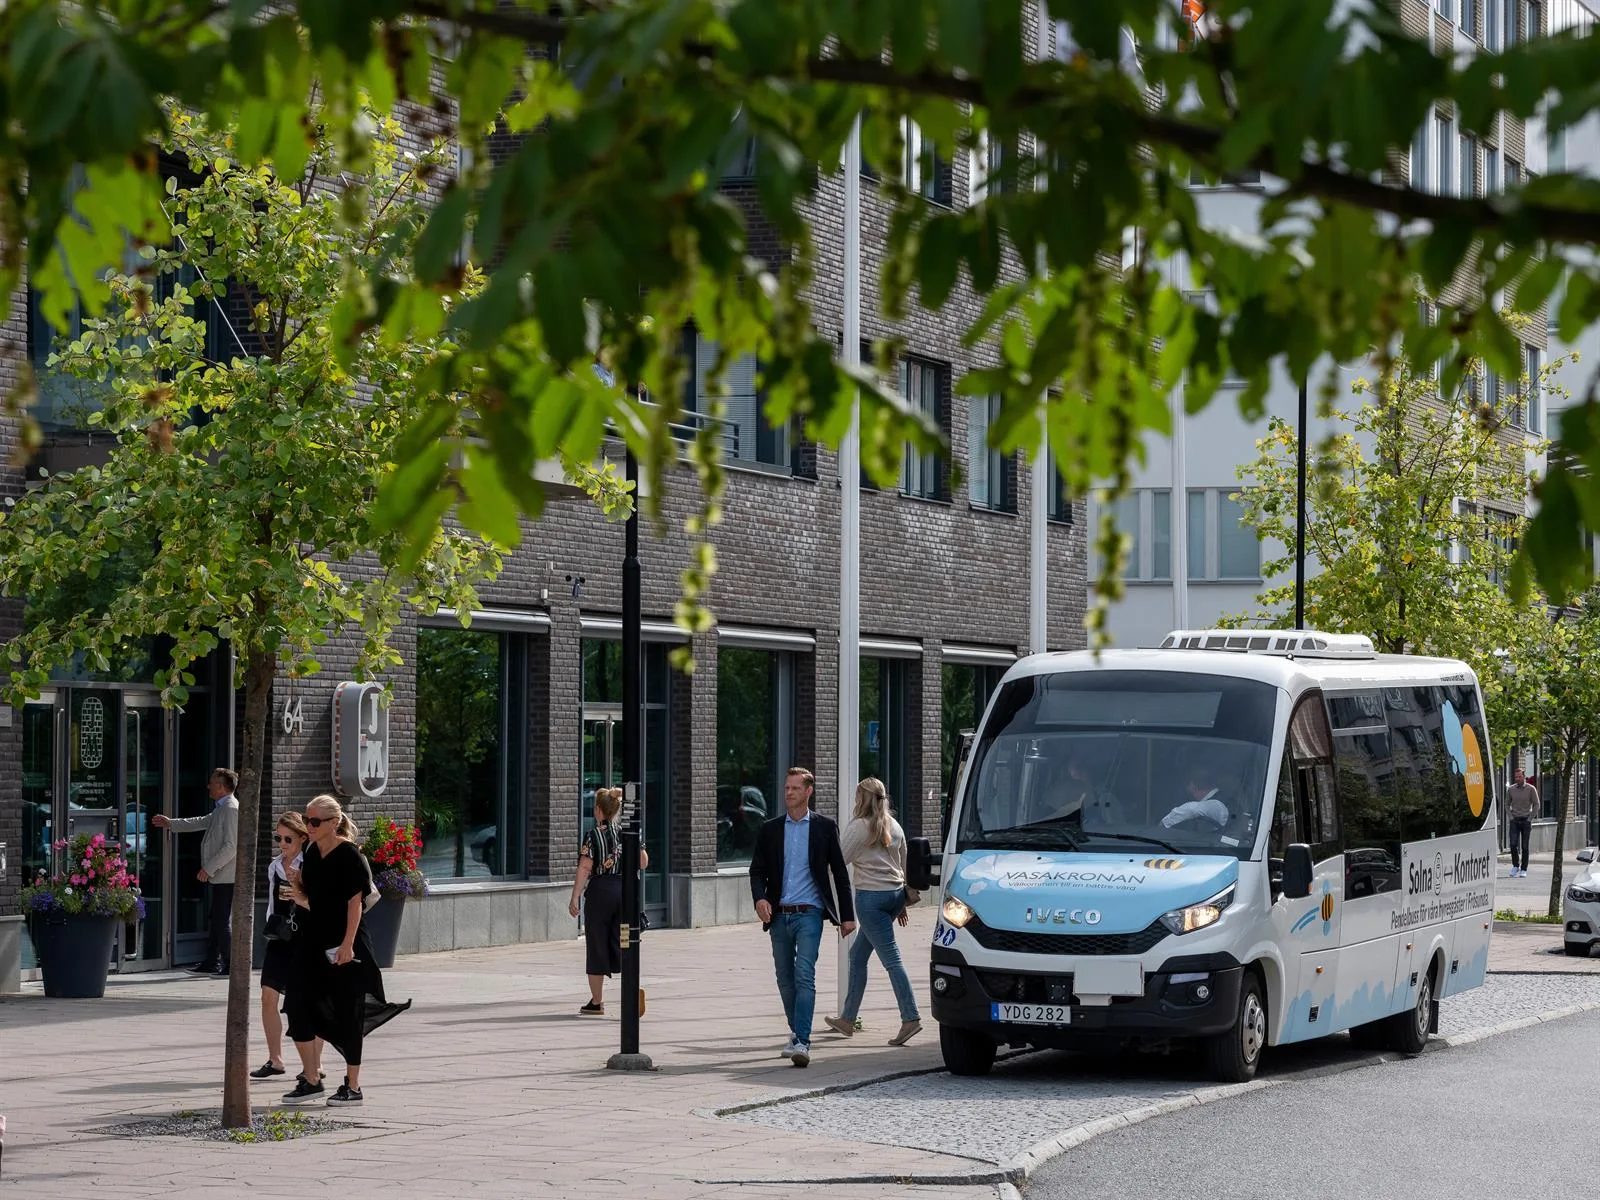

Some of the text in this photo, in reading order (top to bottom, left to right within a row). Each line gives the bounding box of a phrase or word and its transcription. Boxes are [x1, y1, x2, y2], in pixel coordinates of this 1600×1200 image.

[284, 697, 303, 734] 64
[1006, 871, 1146, 884] VASAKRONAN
[1409, 850, 1490, 895] Solna Kontoret
[1025, 907, 1102, 925] IVECO
[1391, 907, 1419, 930] Pendelbuss
[1428, 900, 1438, 920] våra
[1439, 896, 1466, 920] hyresgäster
[1003, 1005, 1064, 1021] YDG 282
